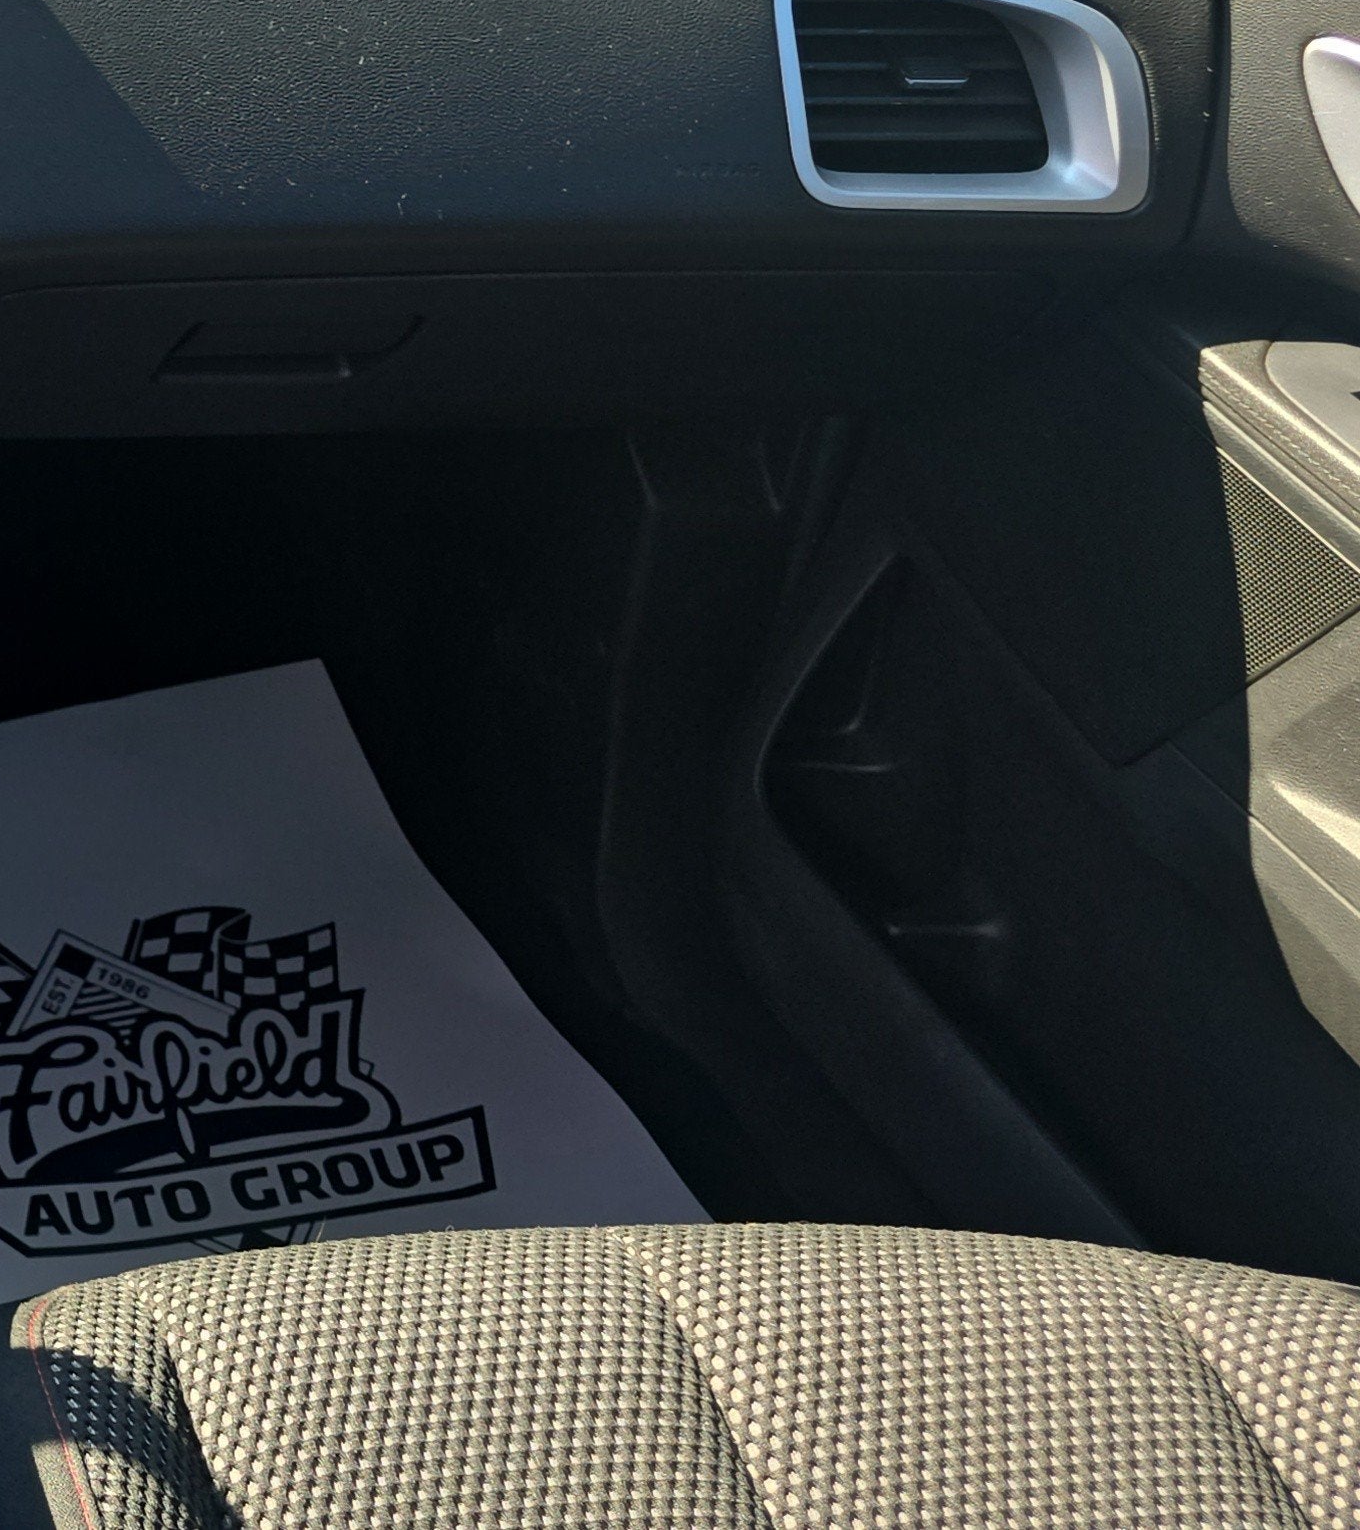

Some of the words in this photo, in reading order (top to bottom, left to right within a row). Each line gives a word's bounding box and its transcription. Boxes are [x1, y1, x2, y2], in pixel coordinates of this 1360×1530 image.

[41, 977, 74, 1016] EST.
[95, 968, 152, 1000] 1986
[24, 1178, 212, 1238] AUTO
[230, 1133, 465, 1212] GROUP
